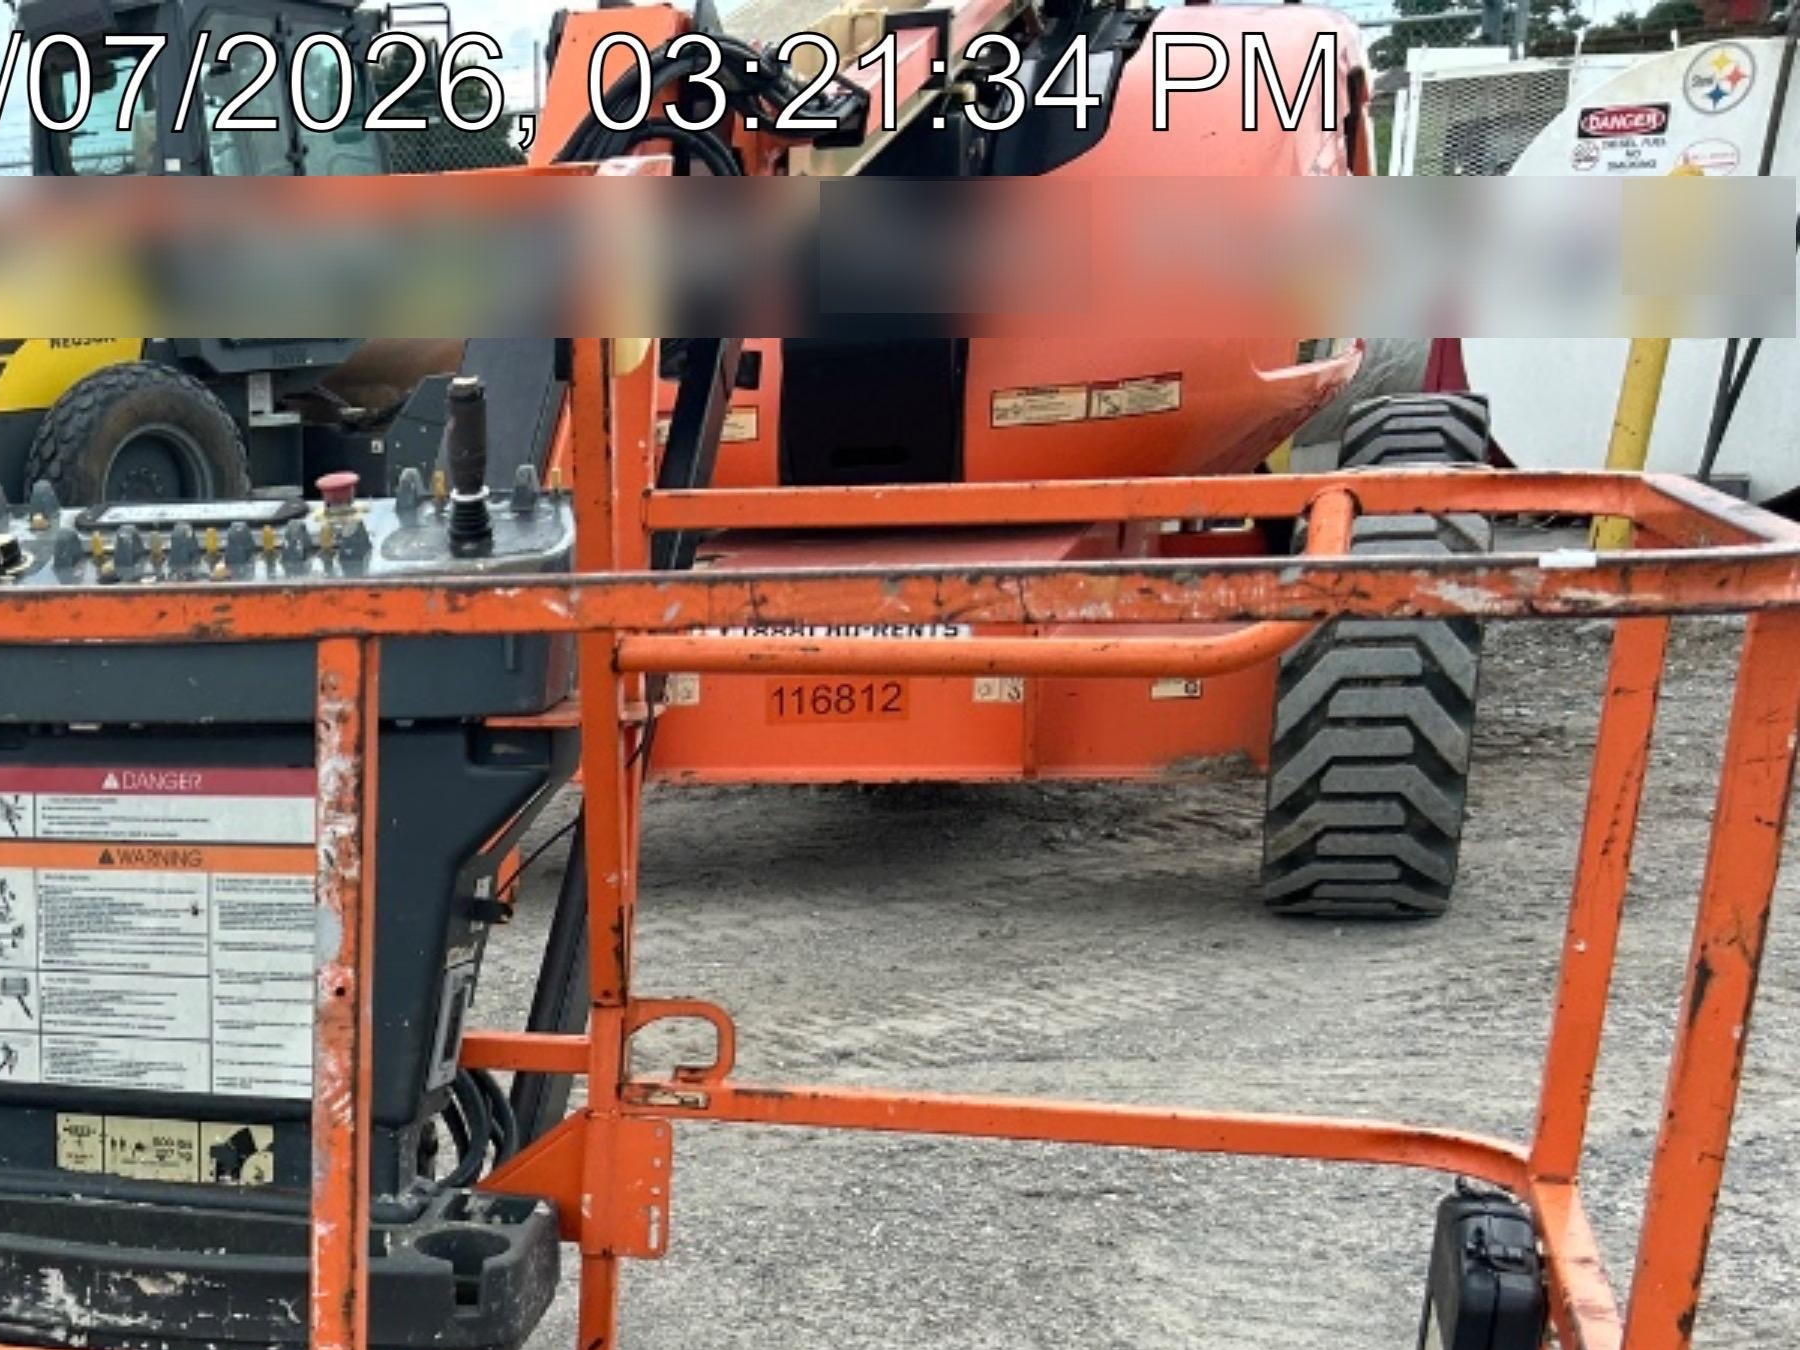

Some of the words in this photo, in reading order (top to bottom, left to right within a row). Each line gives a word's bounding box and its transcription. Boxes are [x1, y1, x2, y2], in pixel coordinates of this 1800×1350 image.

[1588, 111, 1657, 130] DANGER
[772, 683, 902, 717] 116812
[121, 772, 203, 791] DANGER
[116, 849, 204, 867] WARNING
